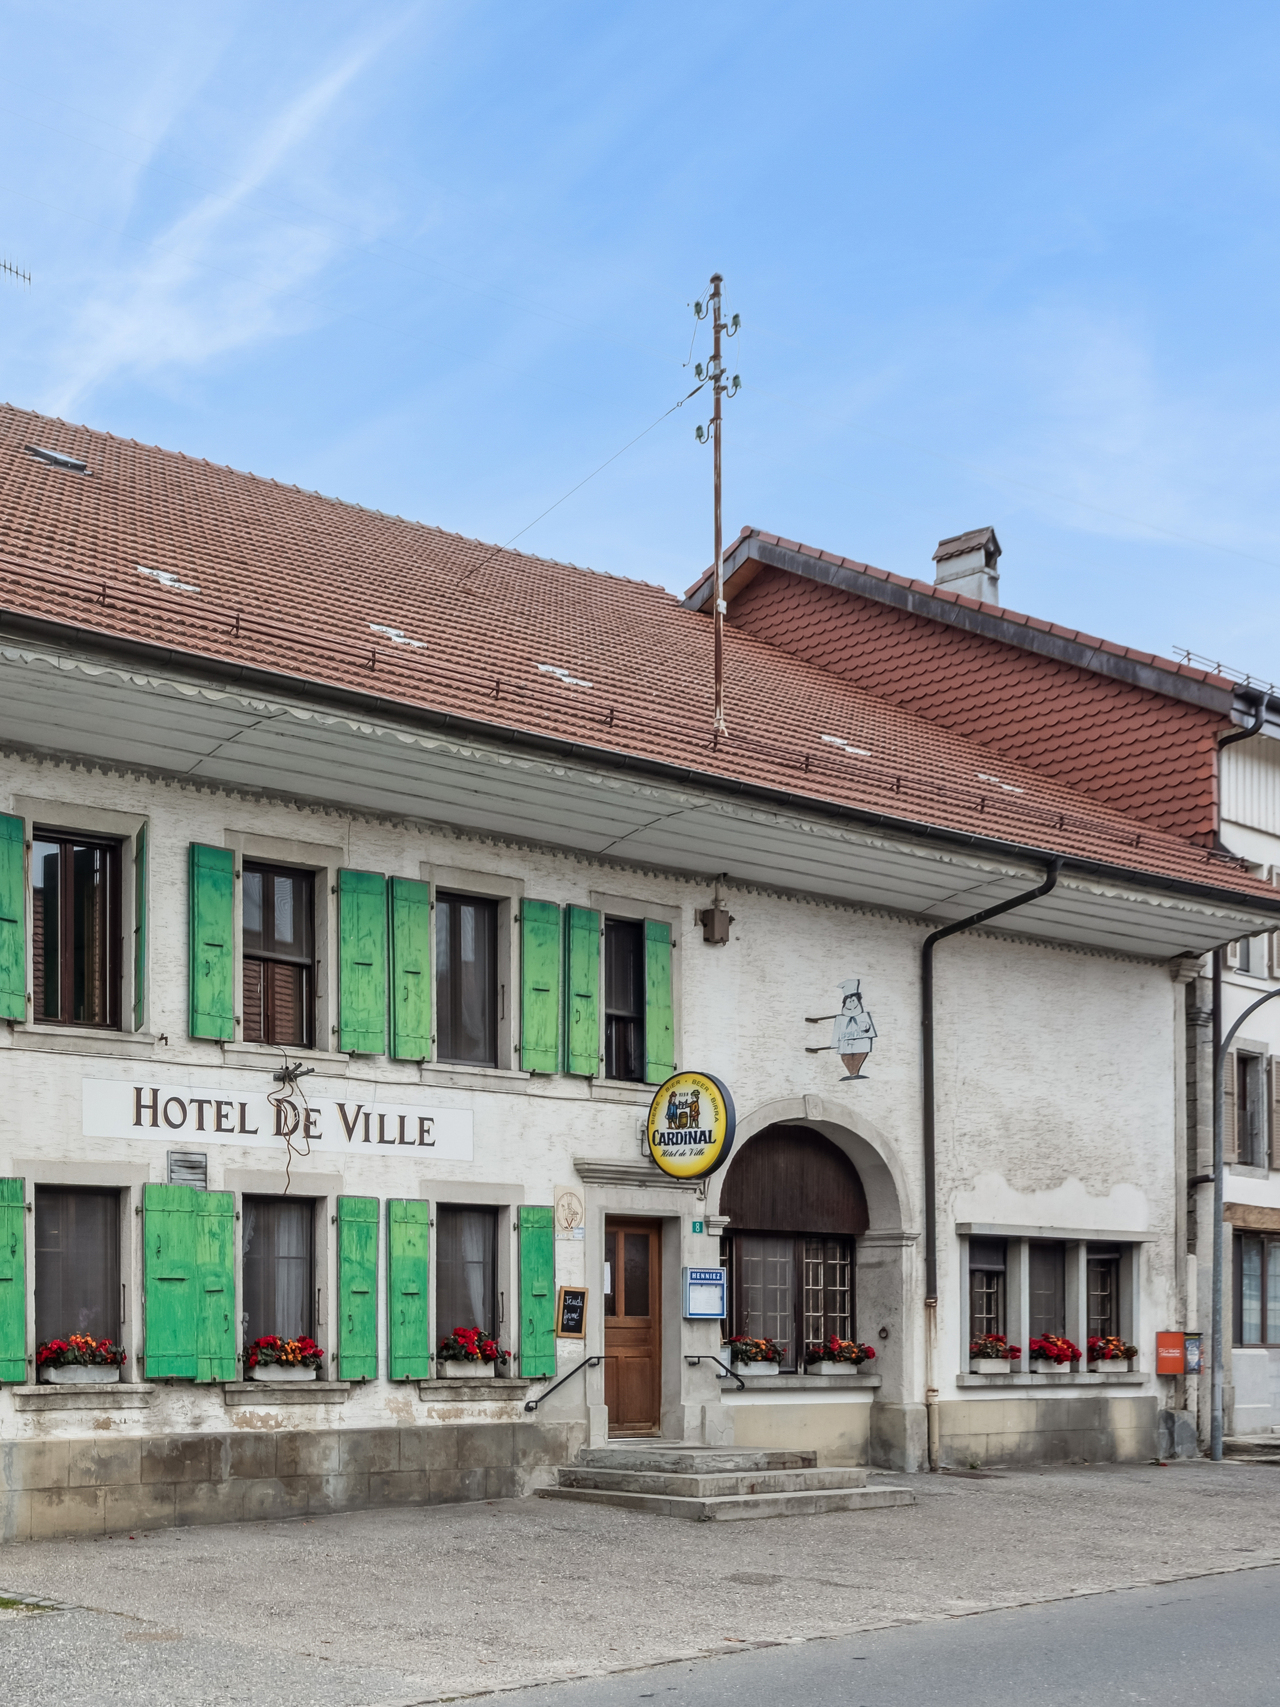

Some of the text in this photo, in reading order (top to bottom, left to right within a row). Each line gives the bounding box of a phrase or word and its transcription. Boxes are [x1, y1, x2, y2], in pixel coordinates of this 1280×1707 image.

[665, 1080, 681, 1093] BIER
[692, 1079, 709, 1092] BEER
[711, 1098, 719, 1123] BIRRA
[132, 1086, 437, 1147] HOTEL DE VILLE
[689, 1147, 705, 1156] Ville
[695, 1222, 700, 1232] 8
[564, 1296, 583, 1306] Jeudi
